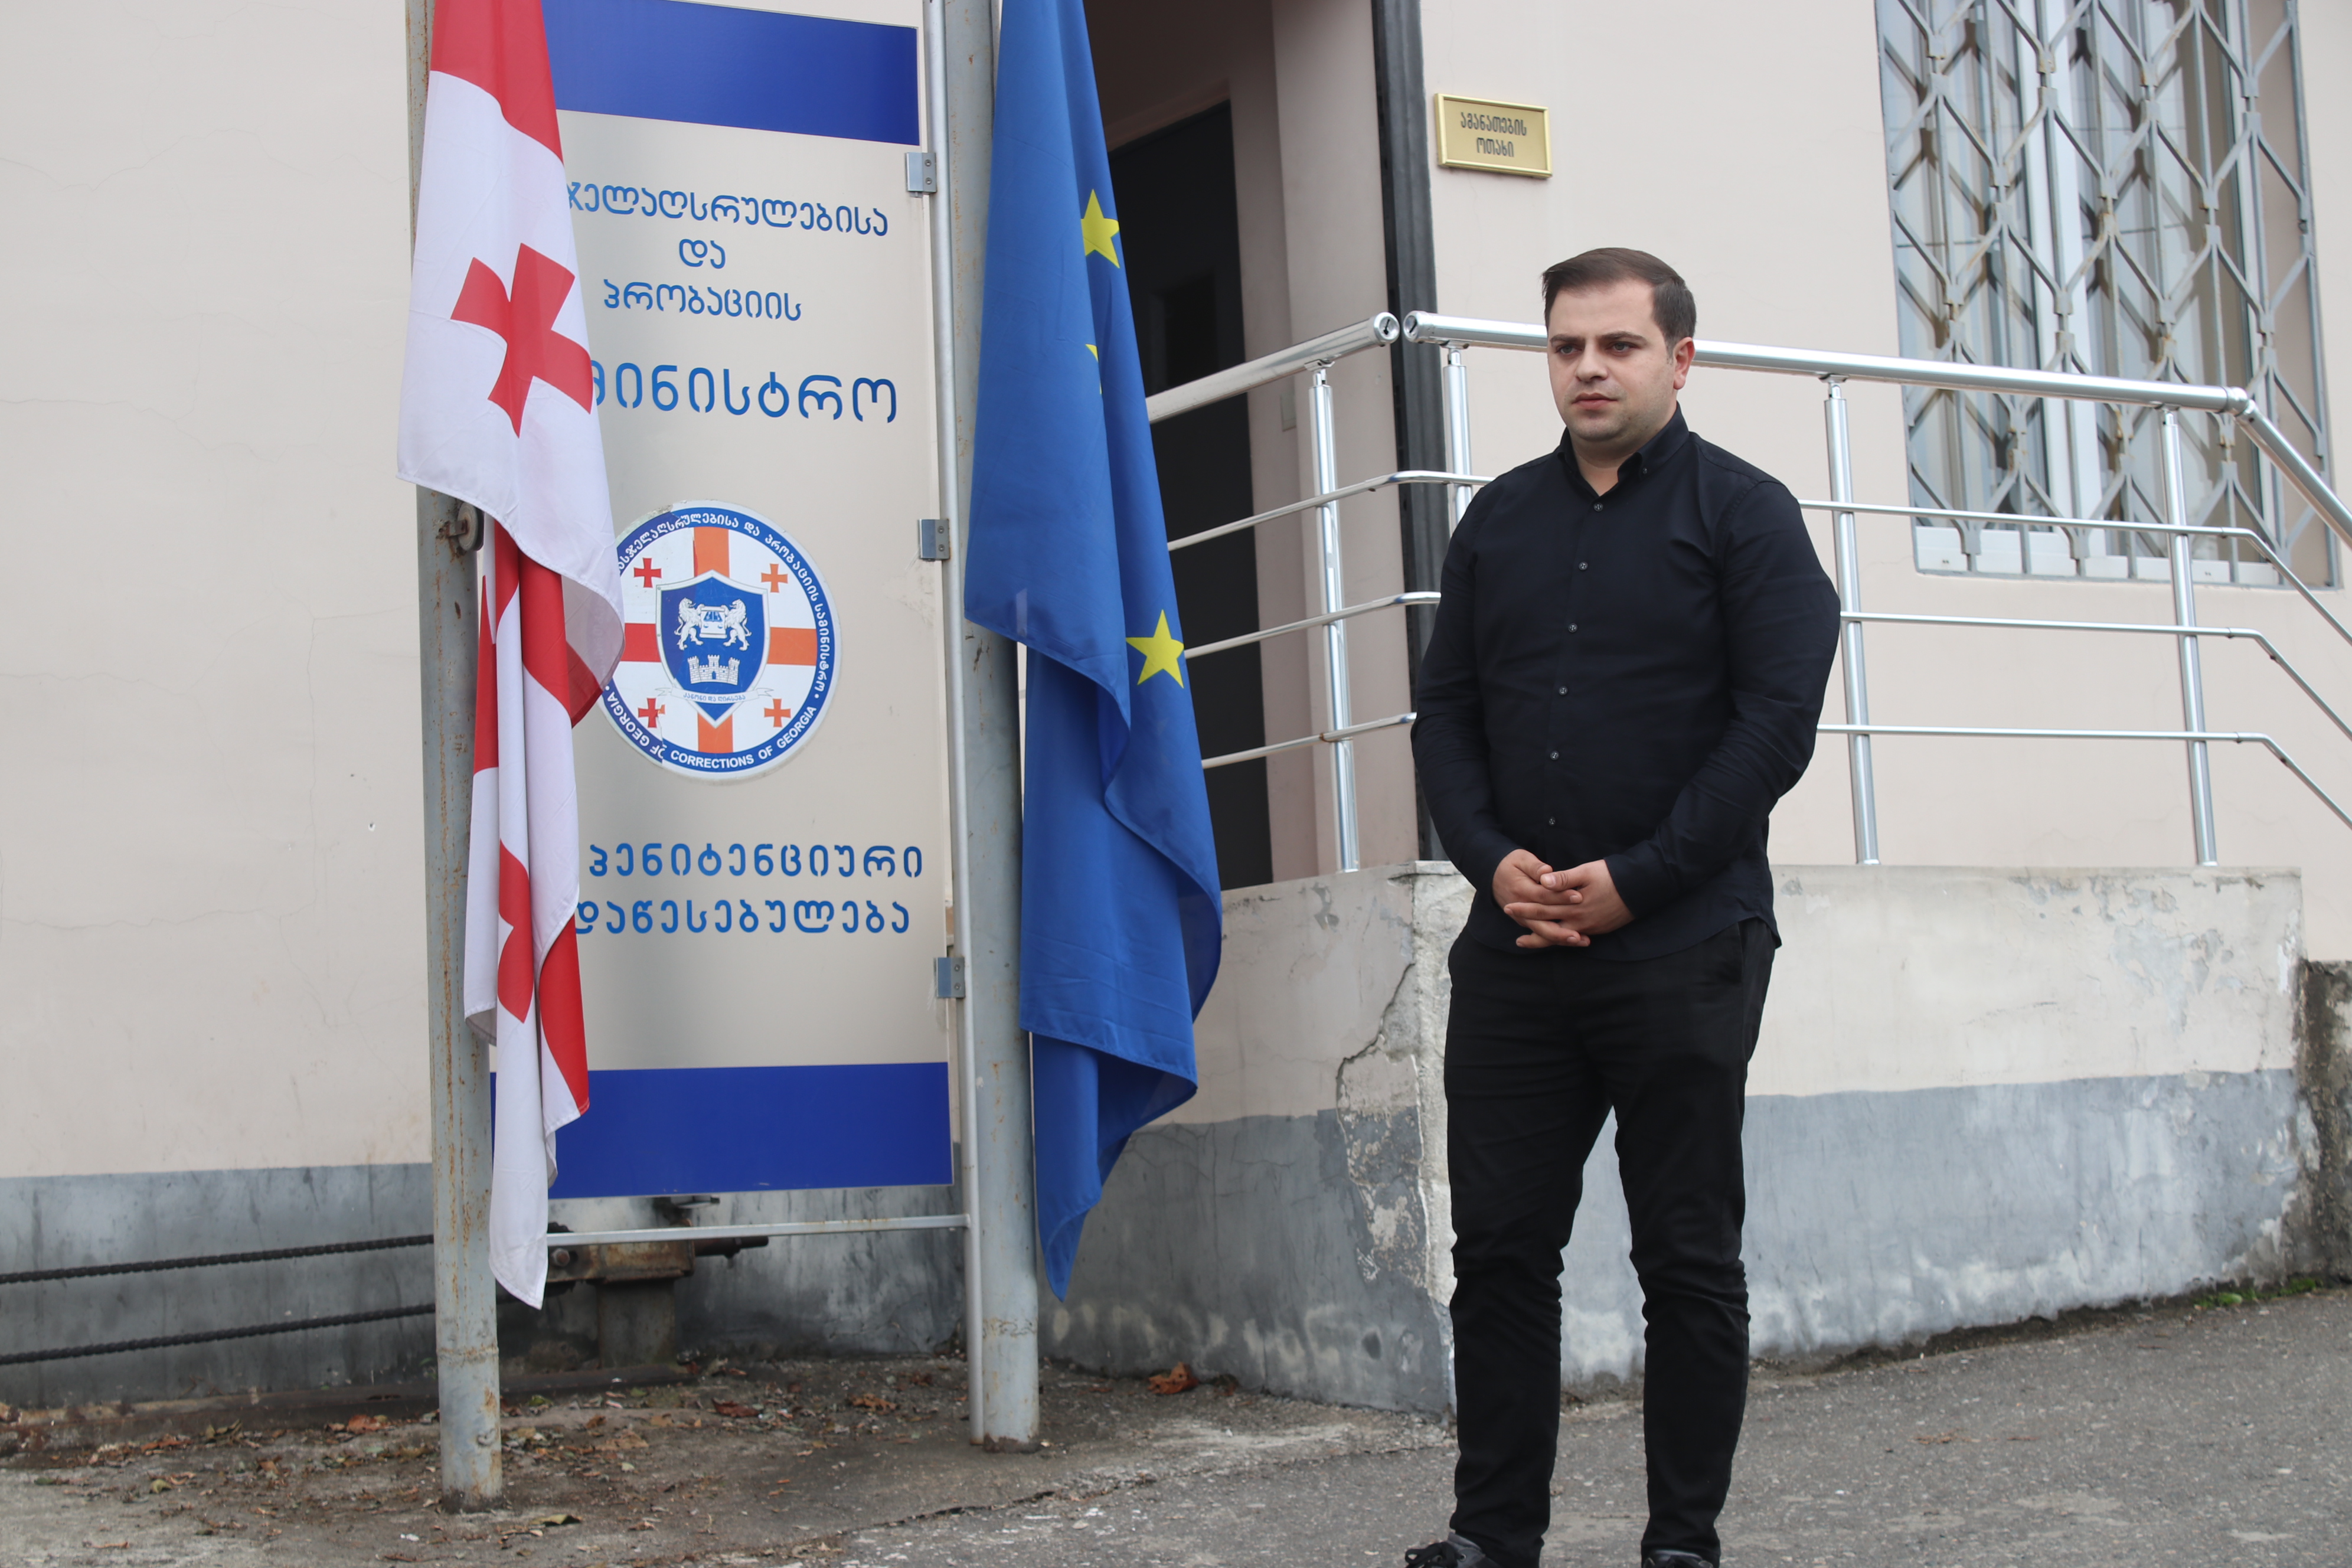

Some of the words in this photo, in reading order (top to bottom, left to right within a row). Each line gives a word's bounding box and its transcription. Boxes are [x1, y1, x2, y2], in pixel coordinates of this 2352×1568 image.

[1461, 112, 1527, 136] ამანათების
[1476, 137, 1514, 158] ოთახი
[567, 181, 887, 236] ჯელაღსრულებისა
[679, 239, 726, 269] და
[603, 279, 801, 321] პრობაციის
[591, 360, 896, 423] მინისტრო
[619, 512, 739, 571] ასჯელაღსრულებისა
[744, 521, 760, 537] და
[765, 534, 818, 602] პრობაციის
[815, 604, 830, 692] სამინისტრო
[607, 691, 650, 747] GEORGIA
[671, 750, 754, 769] CORRECTIONS
[758, 746, 773, 760] OF
[776, 706, 817, 750] GEORGIA
[589, 842, 922, 878] პენიტენციური
[576, 899, 909, 934] დაწესებულება
